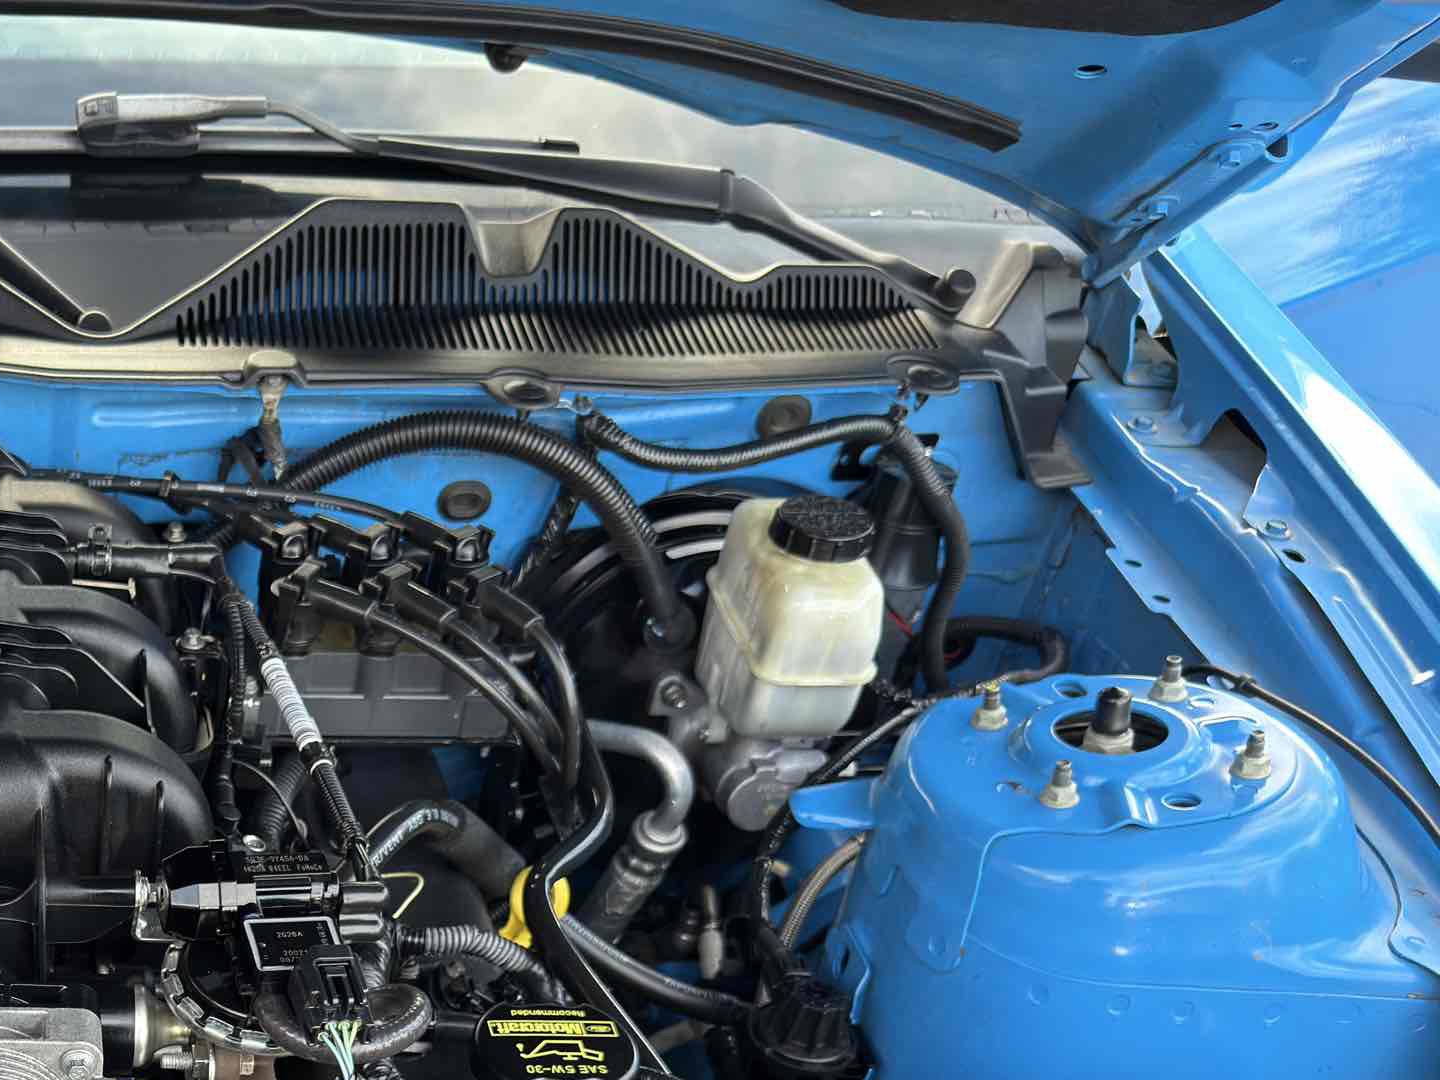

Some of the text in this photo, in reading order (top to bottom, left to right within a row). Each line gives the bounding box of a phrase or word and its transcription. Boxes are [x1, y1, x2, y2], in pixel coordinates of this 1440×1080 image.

[510, 1009, 586, 1017] Recommended
[526, 1064, 609, 1074] SAE 5W-30
